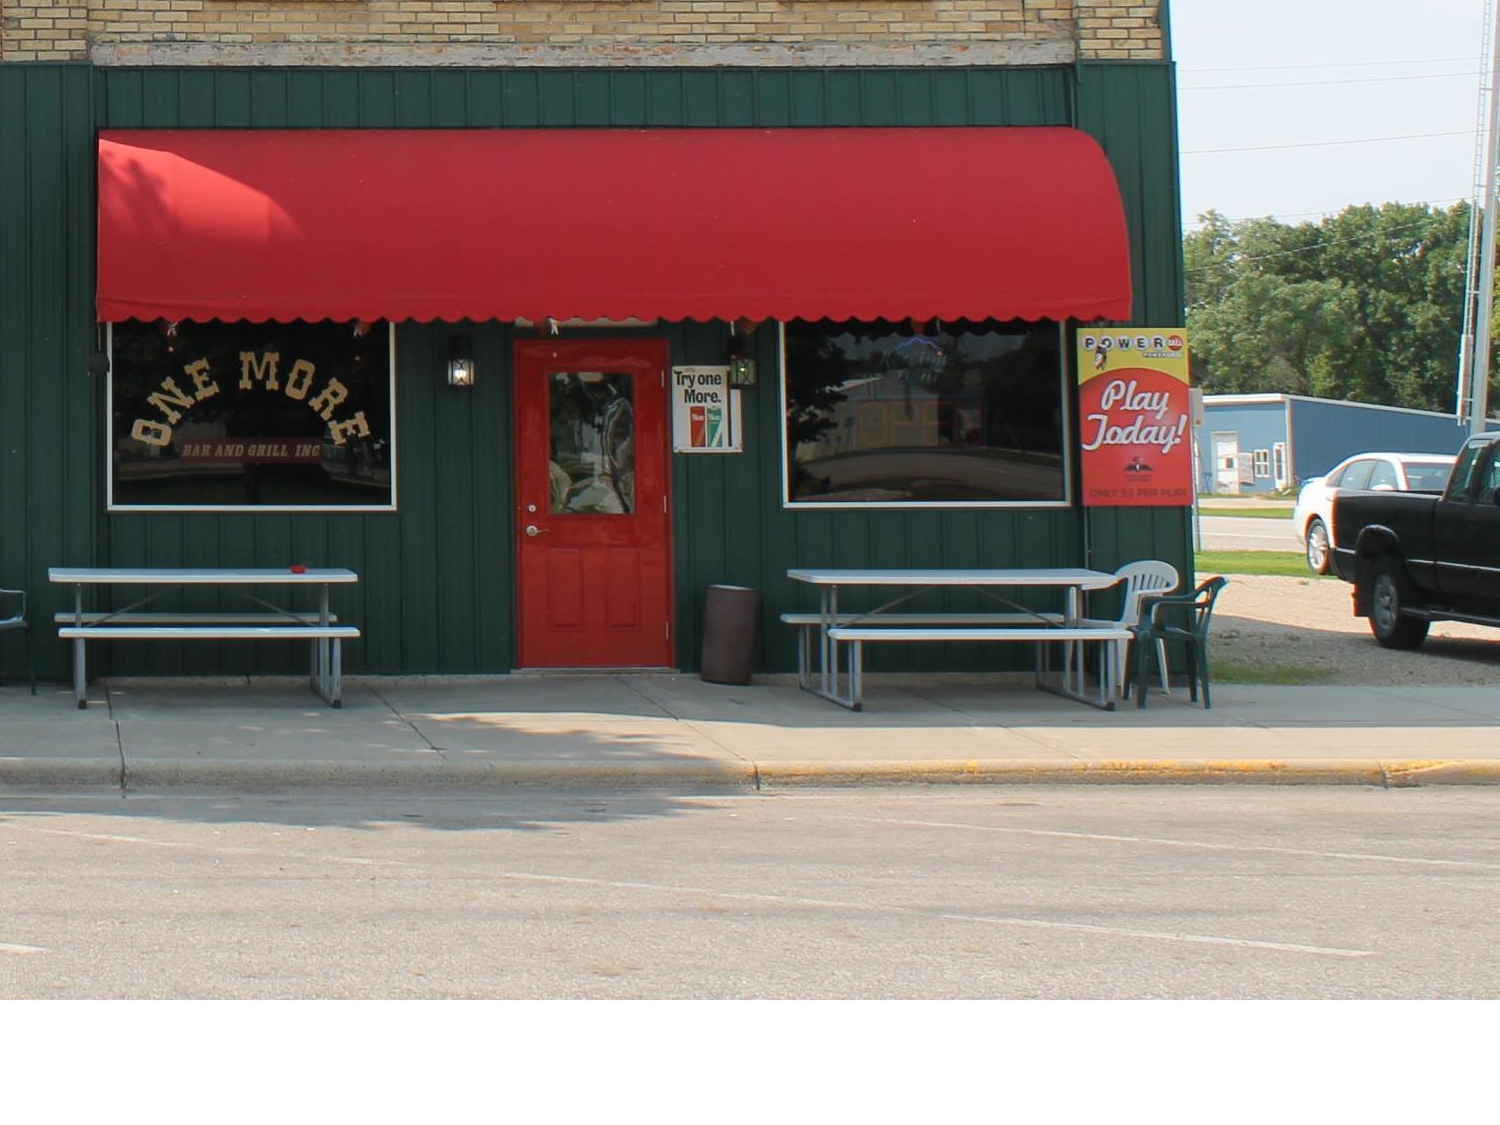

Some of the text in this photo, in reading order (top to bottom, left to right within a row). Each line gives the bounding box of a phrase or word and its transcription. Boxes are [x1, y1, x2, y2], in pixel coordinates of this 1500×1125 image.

[1084, 337, 1164, 349] POWER
[674, 370, 722, 388] Try one
[131, 351, 372, 447] ONE MORE
[683, 388, 722, 403] More.
[1101, 379, 1170, 421] Play
[1082, 412, 1189, 454] Today!
[182, 444, 212, 457] BAR
[214, 444, 245, 457] AND
[247, 444, 289, 457] GRILL
